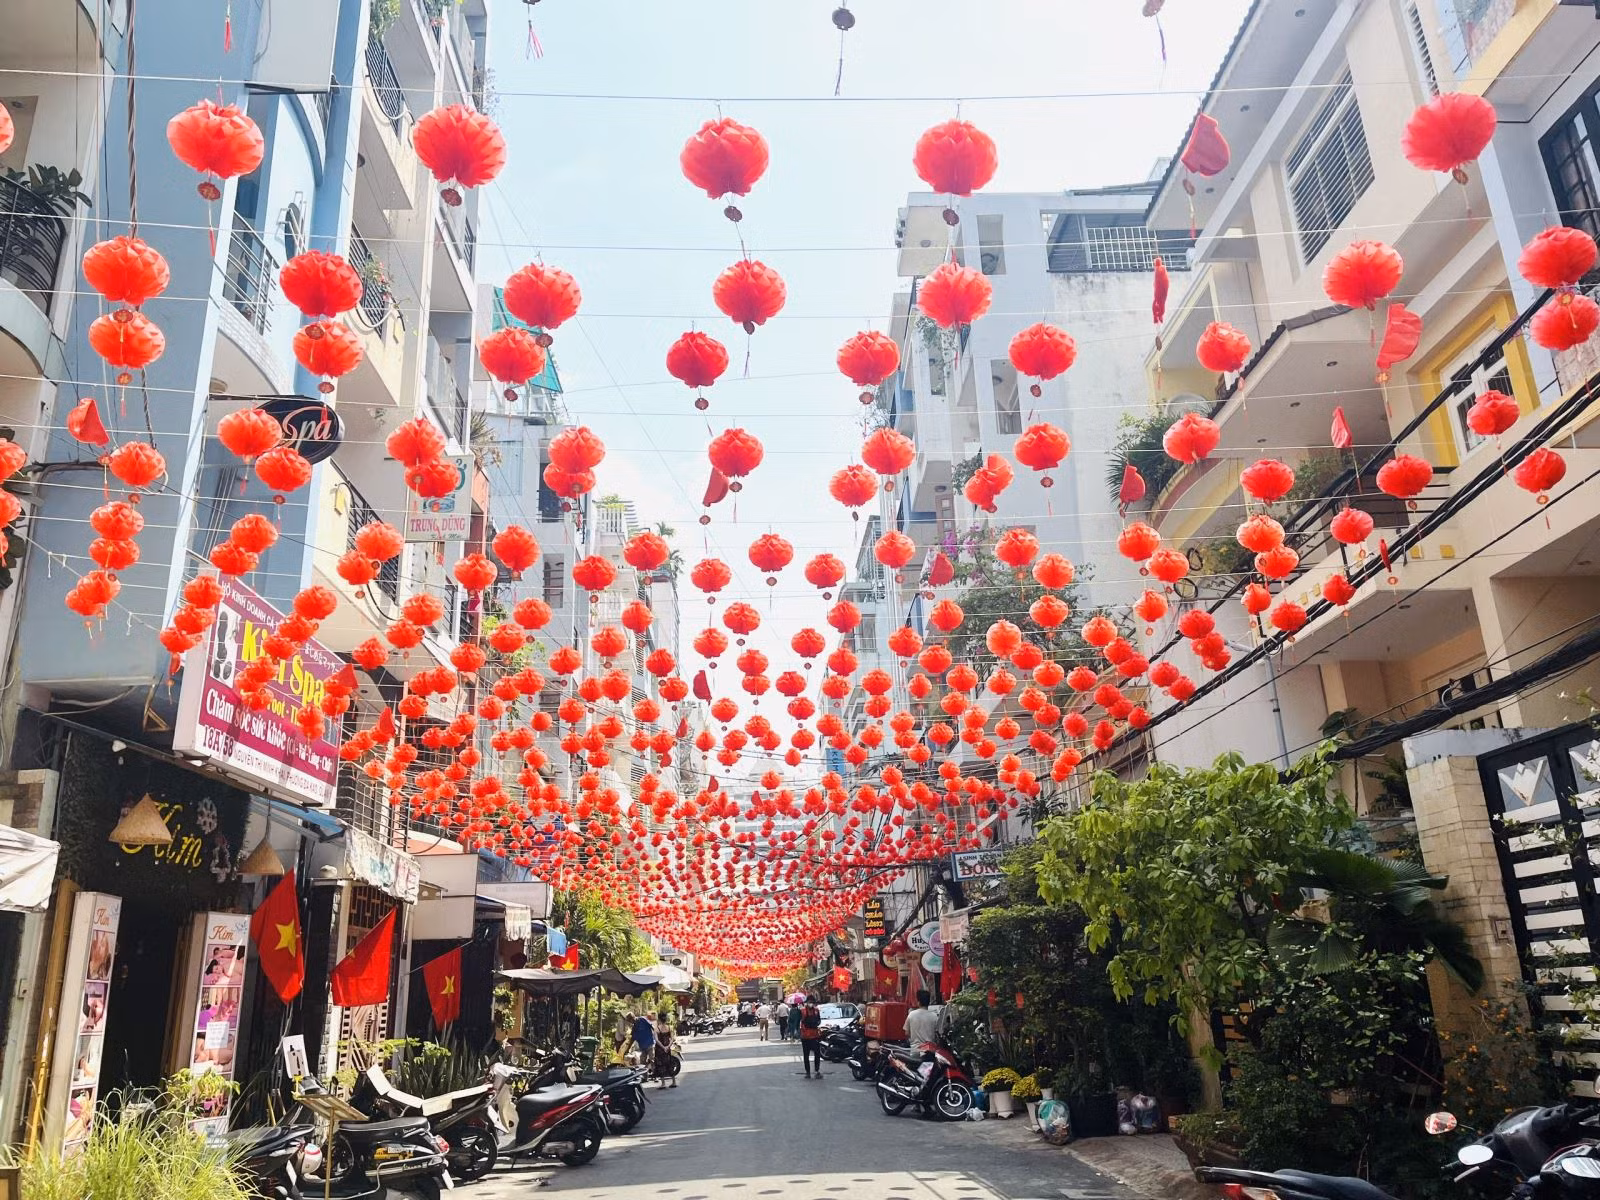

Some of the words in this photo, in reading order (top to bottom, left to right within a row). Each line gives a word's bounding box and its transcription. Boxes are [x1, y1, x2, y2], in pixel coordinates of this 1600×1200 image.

[279, 406, 332, 451] Spa
[410, 518, 440, 532] TRUNG
[242, 619, 286, 685] Ki
[290, 654, 325, 708] Spa
[206, 688, 234, 724] Chăm
[251, 714, 266, 741] sức
[266, 698, 286, 719] oot
[208, 925, 233, 941] Kim
